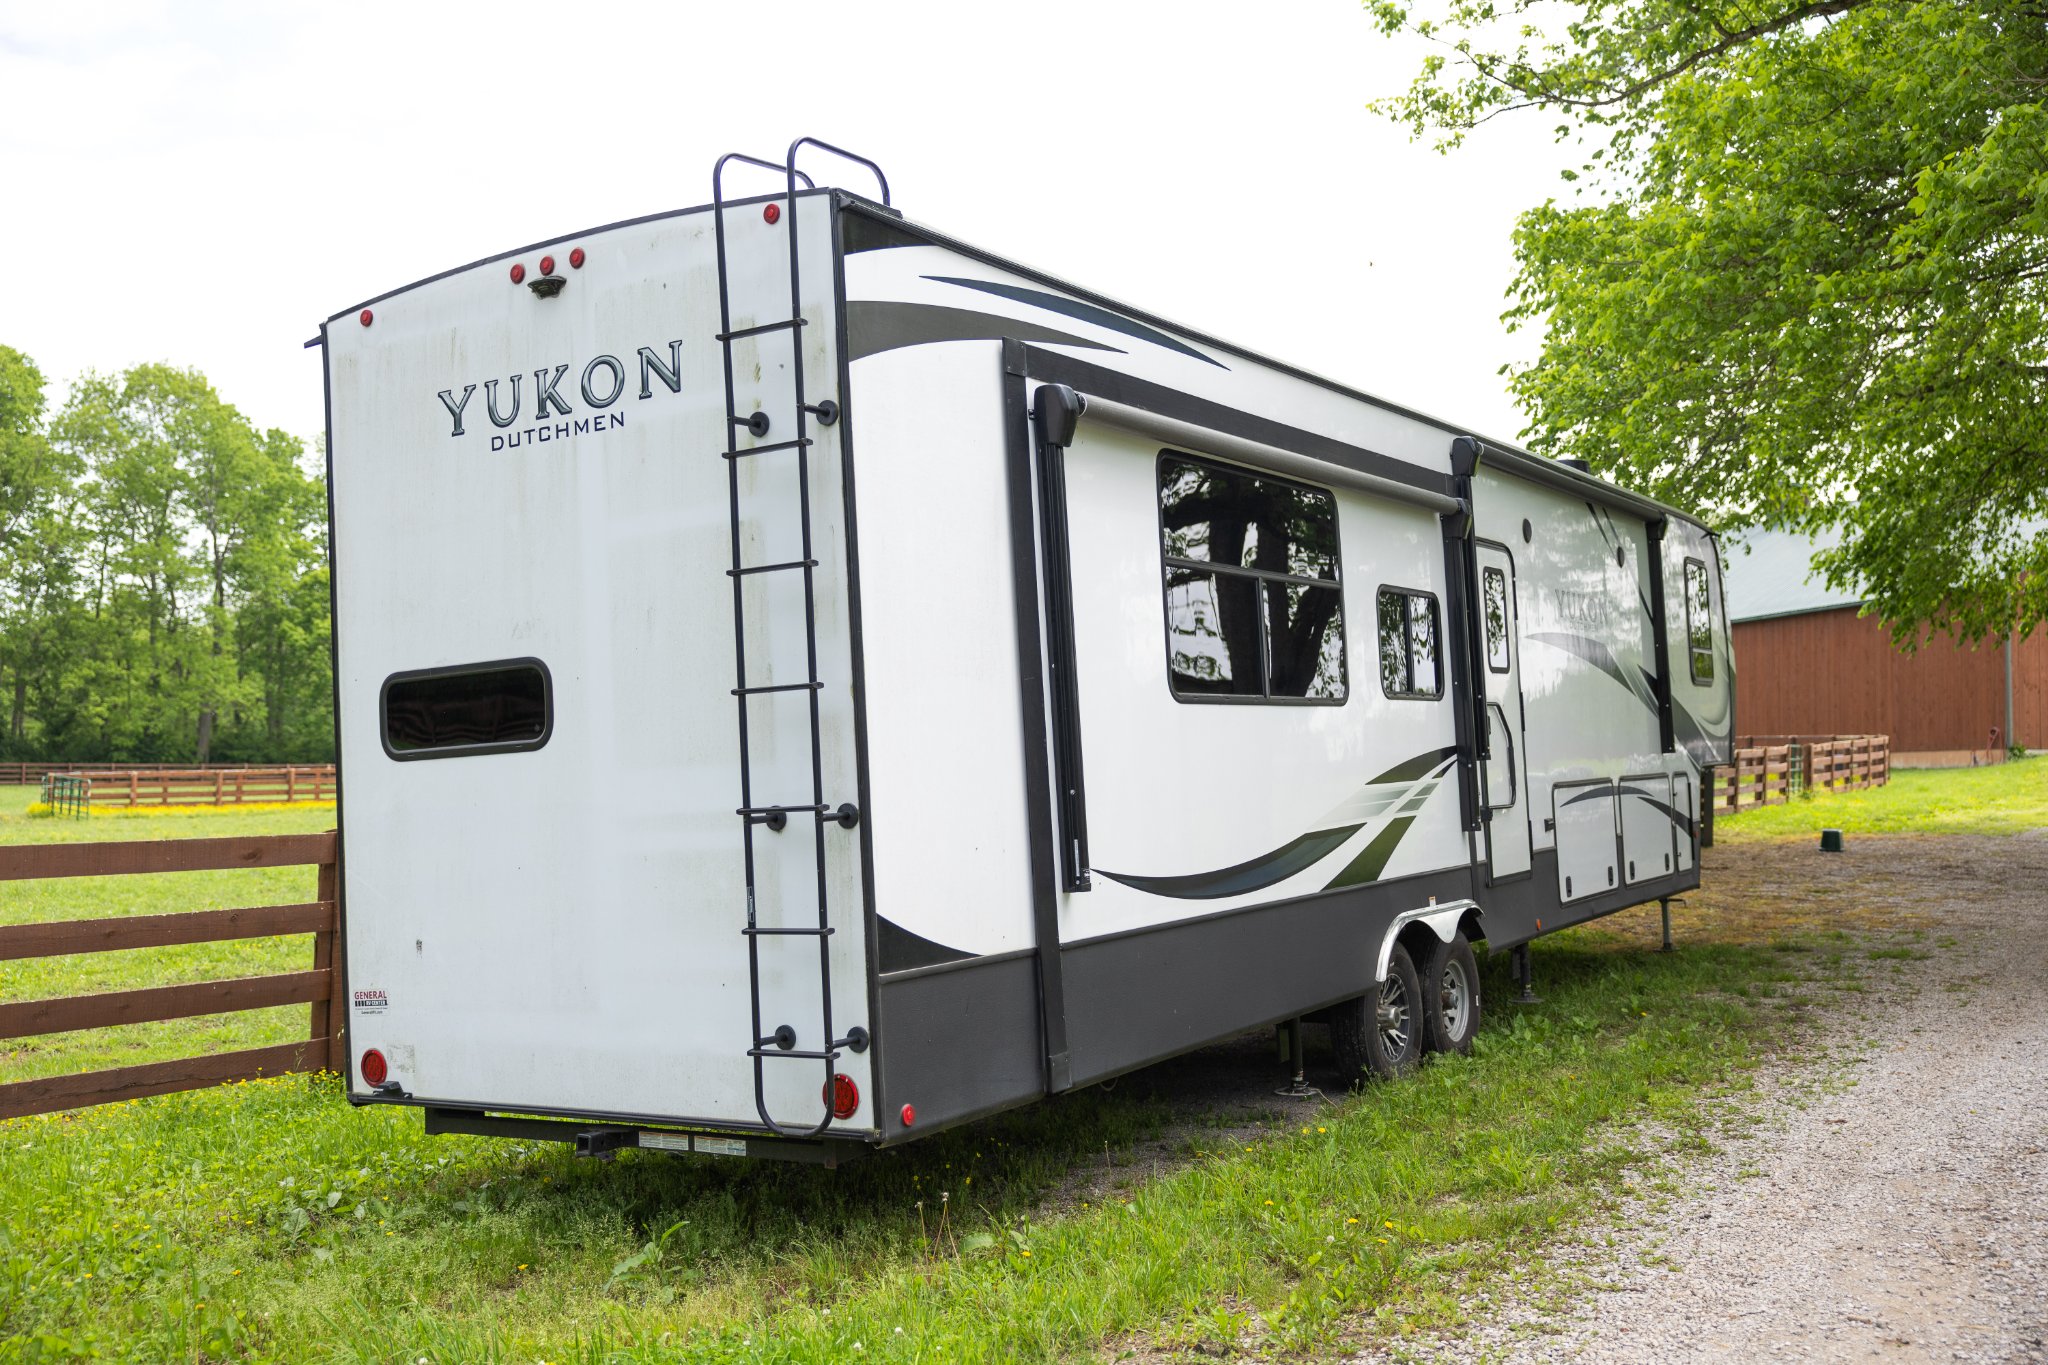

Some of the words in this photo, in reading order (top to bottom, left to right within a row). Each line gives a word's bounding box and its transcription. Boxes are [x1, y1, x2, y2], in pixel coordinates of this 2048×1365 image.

[438, 339, 683, 437] YUKON
[491, 411, 625, 452] DUTCHMEN
[1554, 588, 1609, 625] YUKON
[354, 990, 388, 1000] GENERAL
